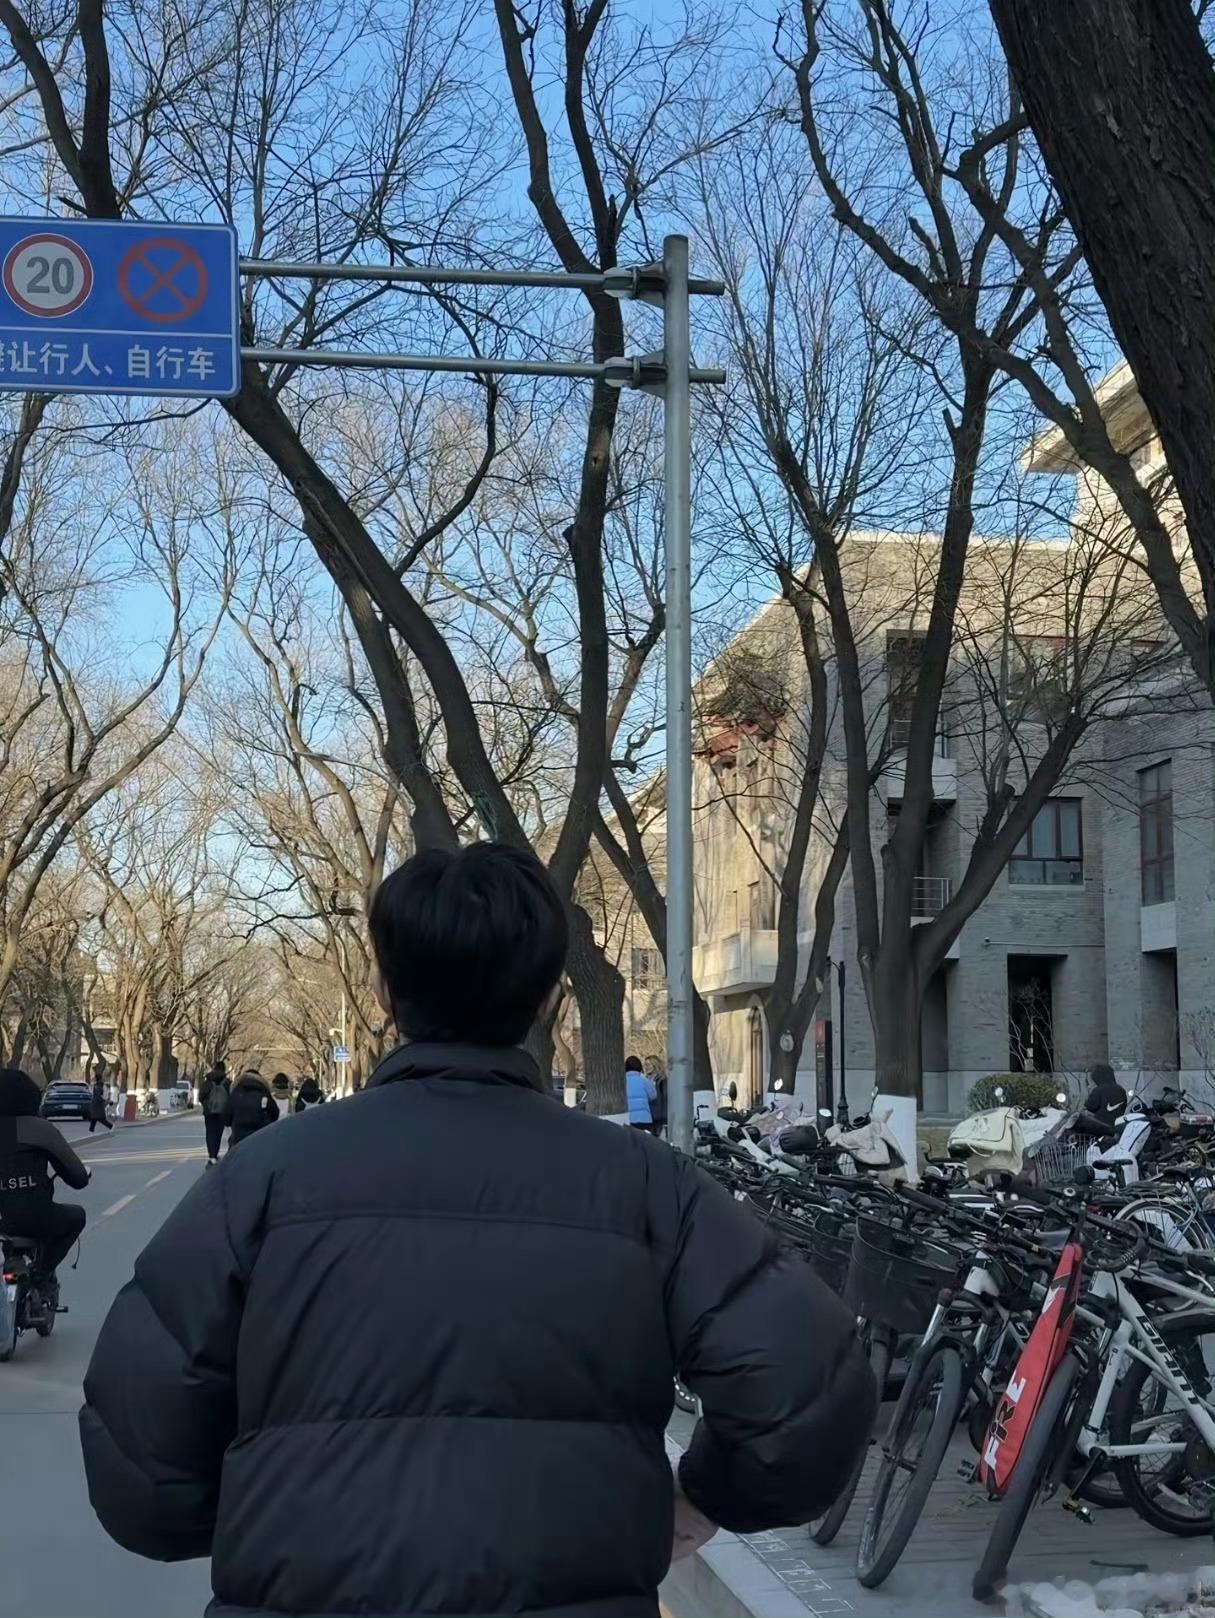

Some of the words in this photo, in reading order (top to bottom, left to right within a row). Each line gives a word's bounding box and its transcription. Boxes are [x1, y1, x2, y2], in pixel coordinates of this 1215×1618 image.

[26, 256, 75, 295] 20
[0, 341, 216, 381] 让行人、自行车
[1136, 1315, 1200, 1405] GIANT
